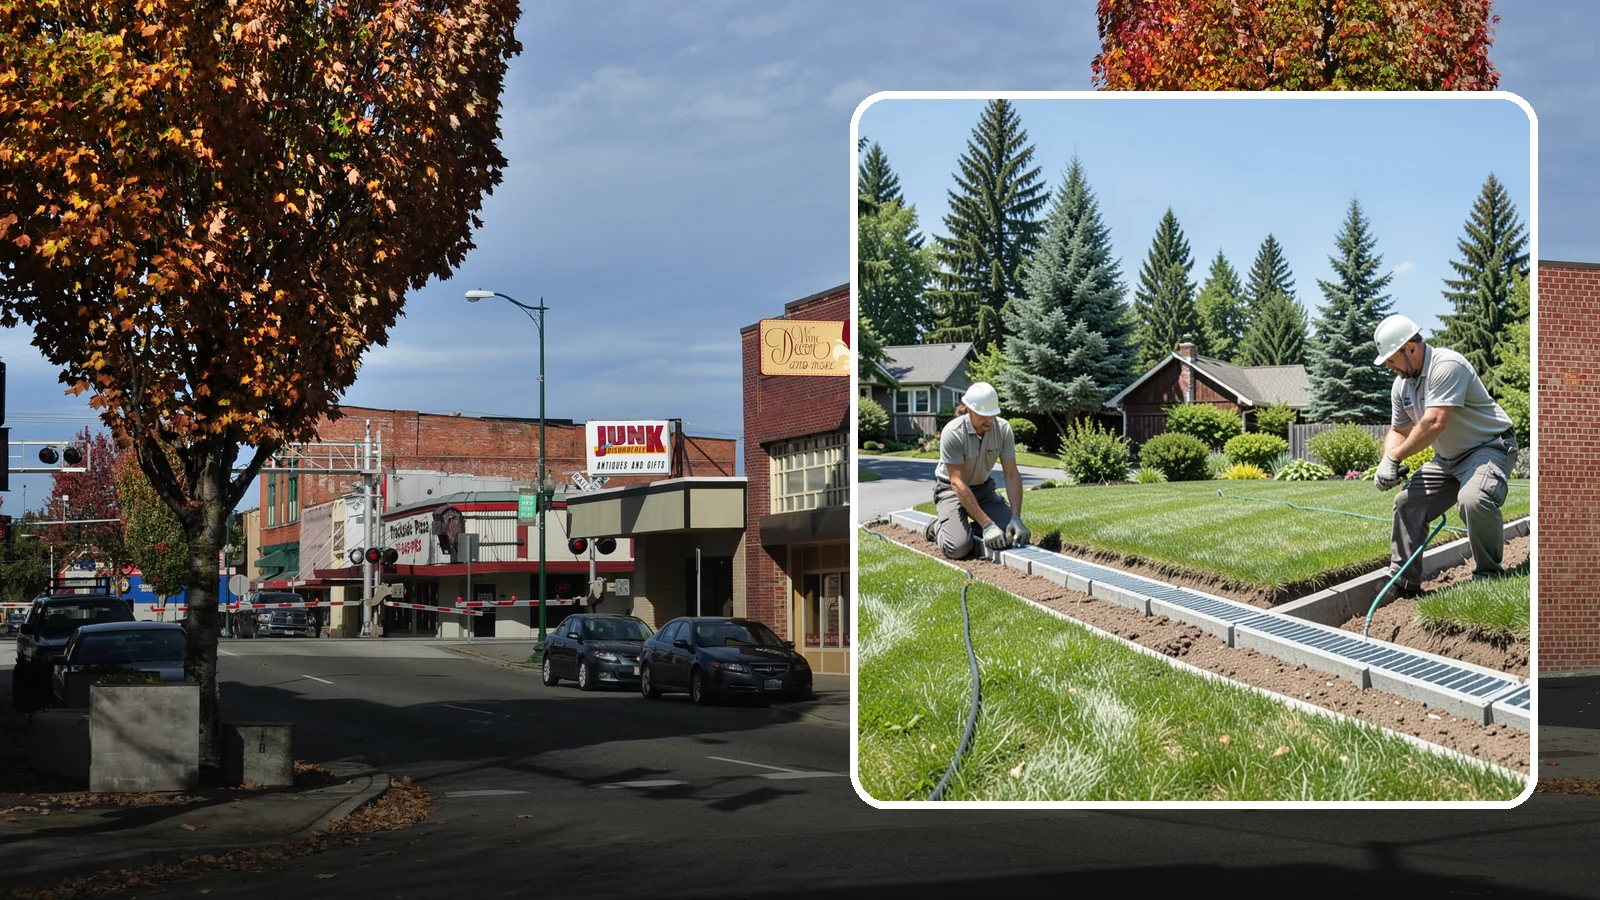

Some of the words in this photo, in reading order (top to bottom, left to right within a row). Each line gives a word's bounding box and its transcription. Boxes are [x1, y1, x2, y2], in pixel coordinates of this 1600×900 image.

[765, 327, 831, 365] Decor
[595, 425, 665, 457] JUNK
[607, 446, 645, 454] DISORDERLY
[597, 461, 628, 470] ANTIQUES
[631, 461, 643, 470] AND
[647, 460, 665, 470] GIFTS
[390, 521, 413, 539] Trackside
[414, 519, 429, 534] Pizza
